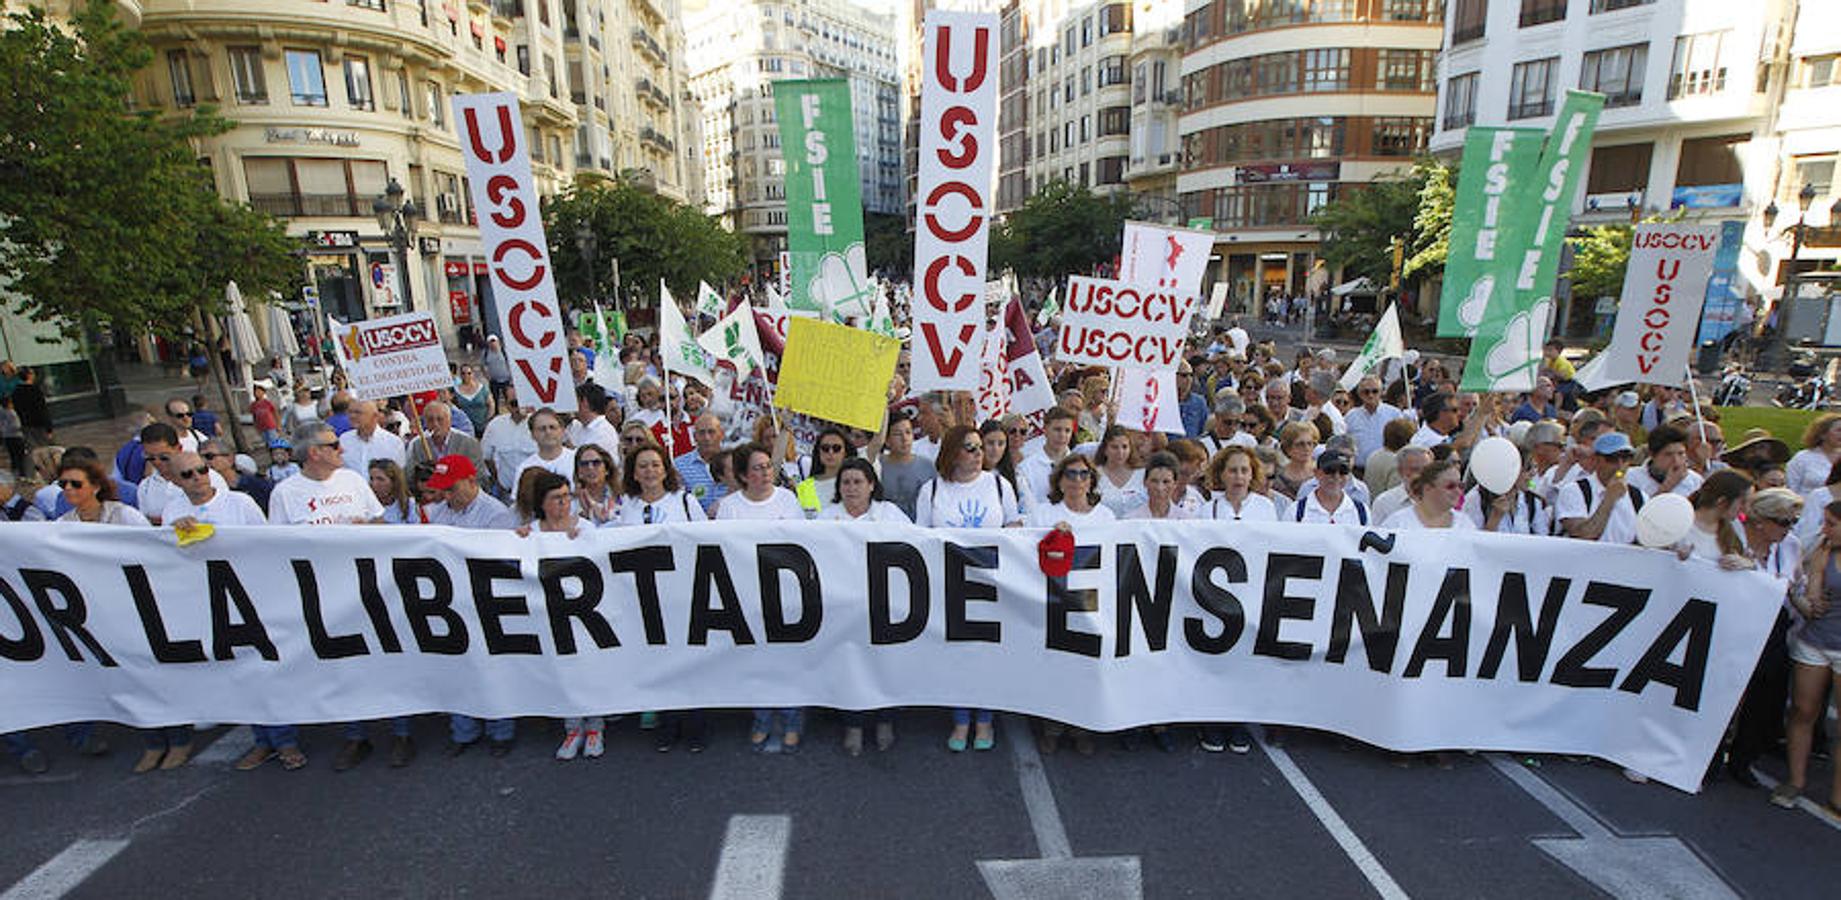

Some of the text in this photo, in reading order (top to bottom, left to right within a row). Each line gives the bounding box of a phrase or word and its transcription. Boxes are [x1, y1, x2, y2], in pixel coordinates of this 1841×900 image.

[800, 93, 835, 236] FSIE
[920, 26, 990, 378] USOCV
[1474, 130, 1516, 261] FSIE
[1515, 111, 1588, 291] FSIE
[463, 106, 562, 405] USOCV
[1069, 282, 1194, 325] USOCV
[1633, 231, 1717, 252] USOCV
[366, 320, 433, 349] USOCV
[1061, 325, 1184, 366] USOCV
[1635, 257, 1682, 376] USOCV
[122, 559, 279, 664] LA
[291, 543, 824, 661] LIBERTAD
[867, 541, 1002, 646] DE
[1045, 531, 1718, 713] ENSEÑANZA
